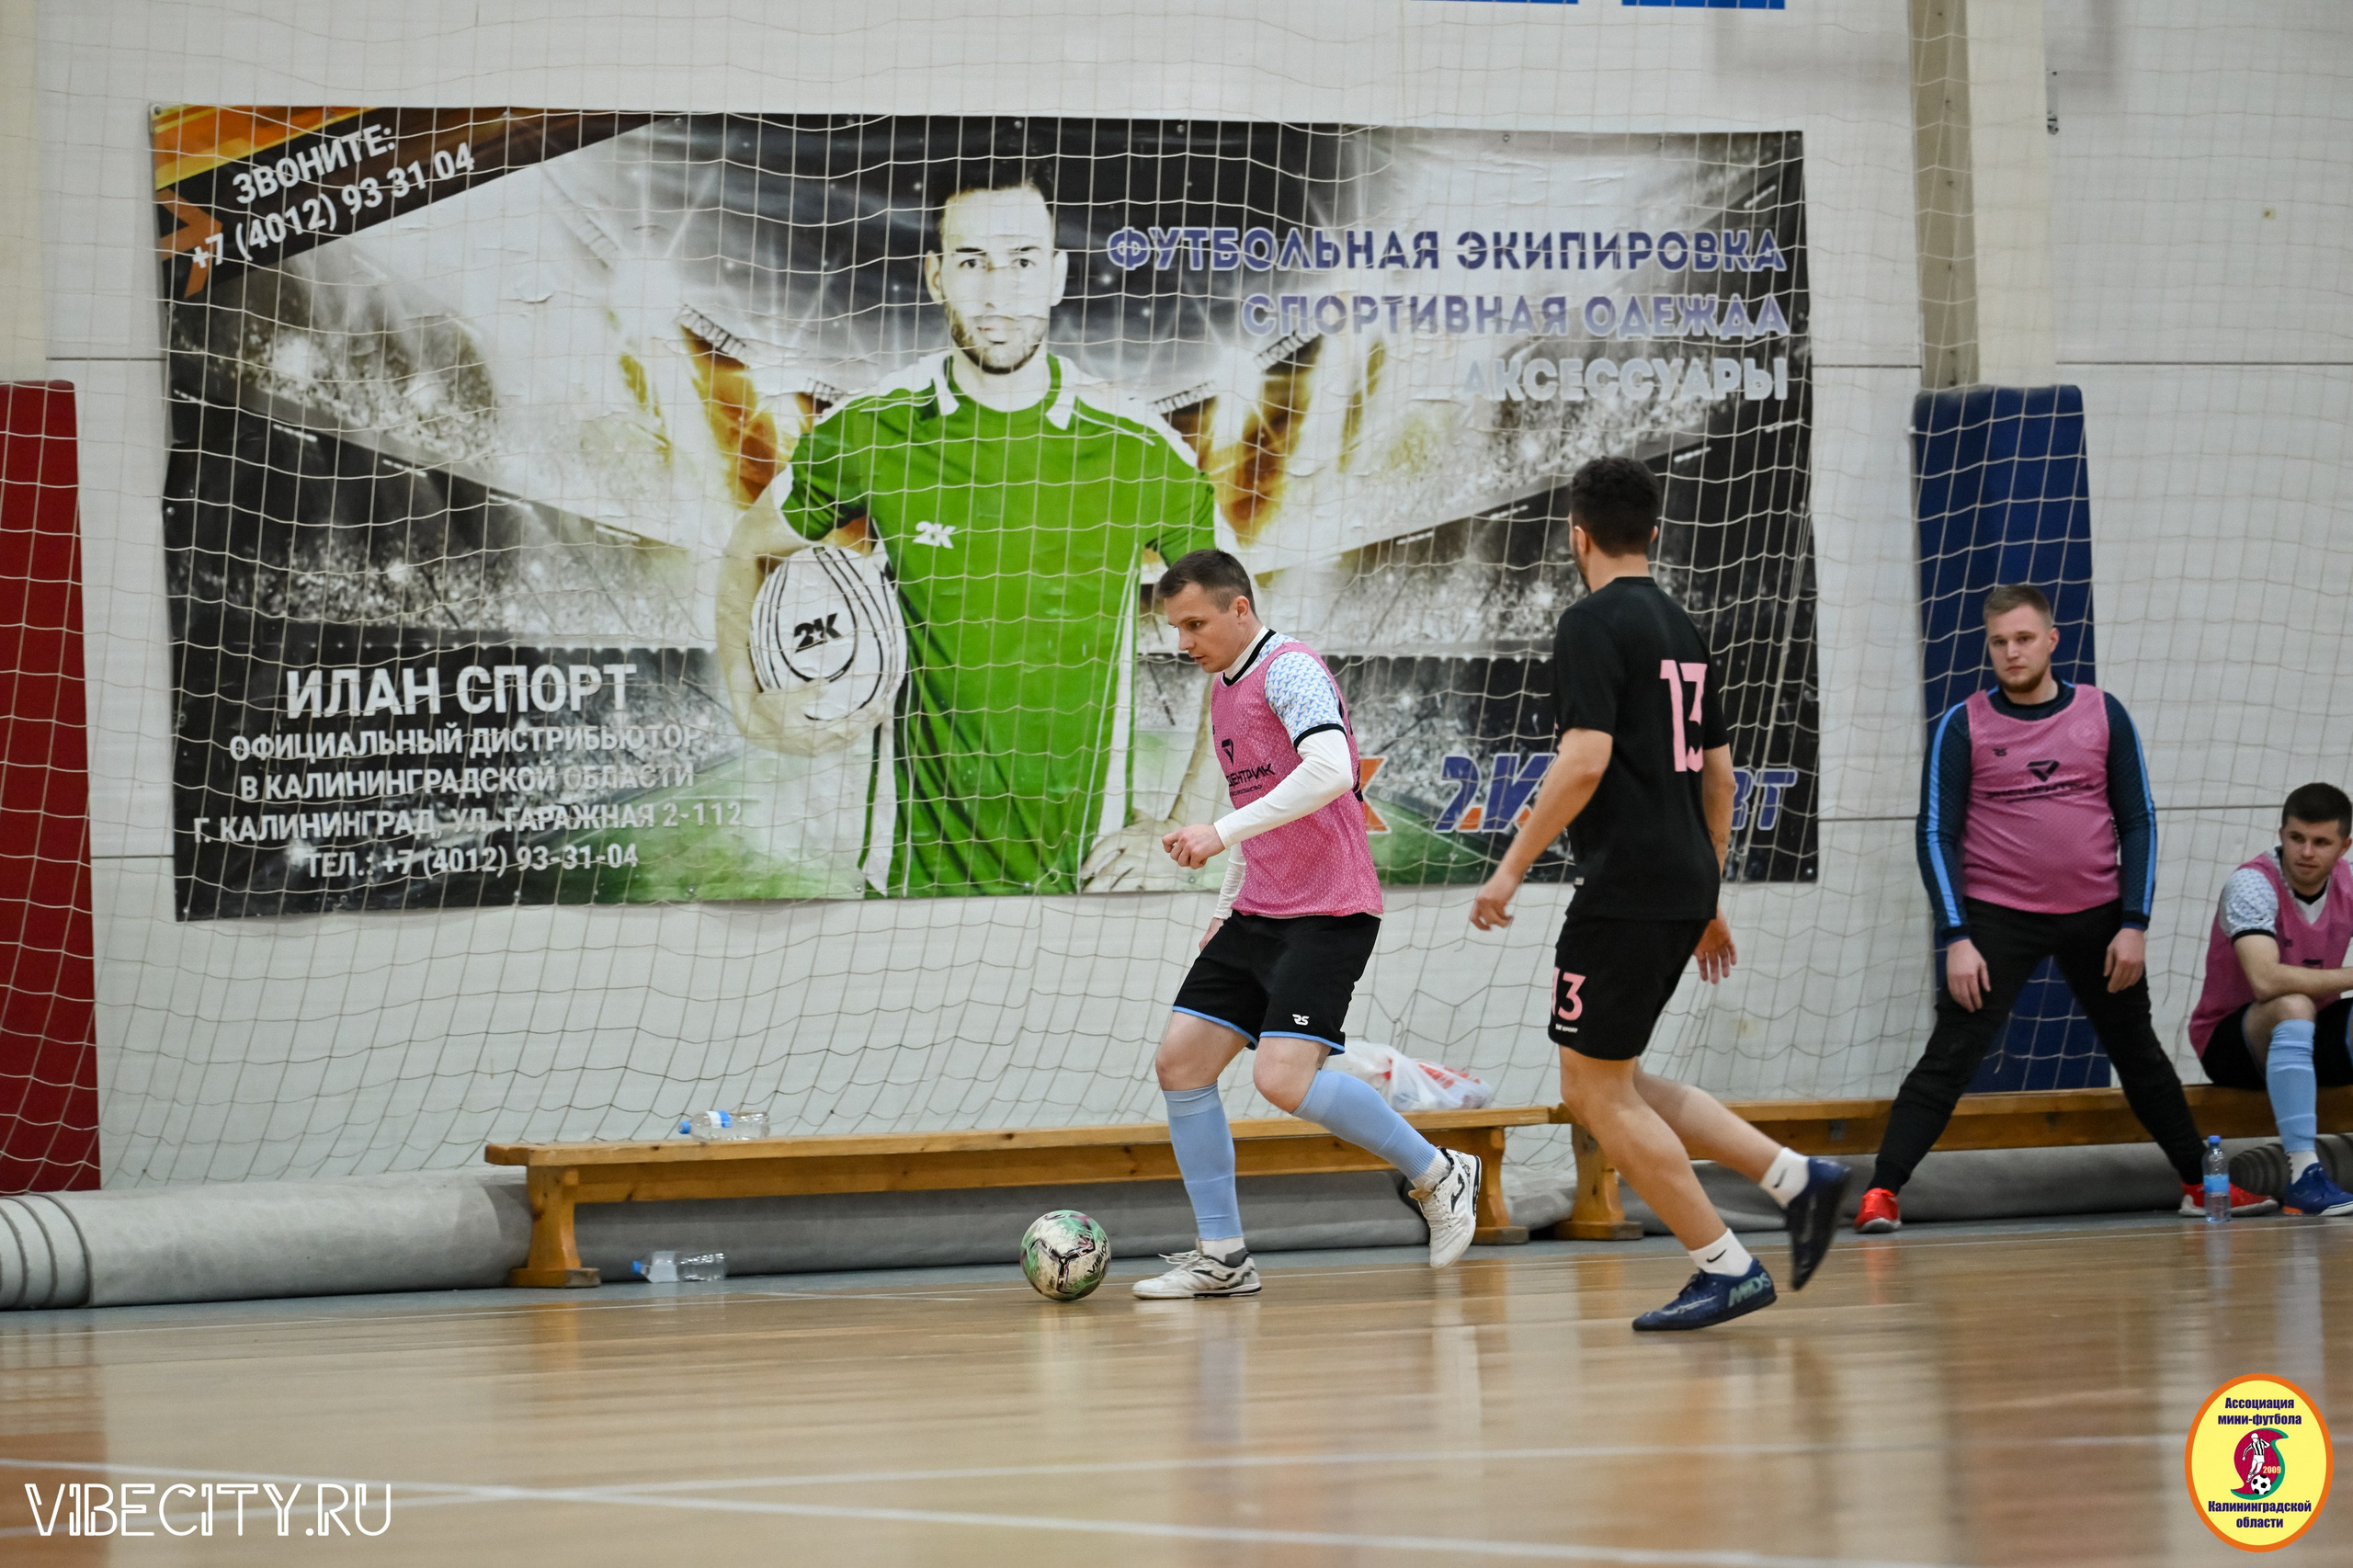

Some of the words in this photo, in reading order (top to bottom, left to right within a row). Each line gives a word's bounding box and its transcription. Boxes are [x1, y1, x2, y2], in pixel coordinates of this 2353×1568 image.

[233, 124, 396, 204] ЗВОНИТЕ:
[192, 232, 224, 268] +7
[235, 193, 336, 262] (4012)
[341, 177, 383, 216] 93
[386, 160, 427, 199] 31
[434, 142, 476, 180] 04
[1107, 227, 1439, 272] ФУТБОЛЬНАЯ
[1456, 230, 1788, 273] ЭКИПИРОВКА
[1242, 292, 1569, 338] СПОРТИВНАЯ
[1583, 292, 1790, 340] ОДЕЖДА
[1461, 357, 1789, 403] АКСЕССУАРЫ
[912, 520, 957, 550] 2K
[793, 612, 843, 653] 2K
[286, 666, 442, 720] ИЛАН
[457, 664, 637, 714] СПОРТ
[230, 722, 462, 764] ОФИЦИАЛЬНЫЙ
[470, 723, 703, 759] ДИСТРИБЬЮТОР
[241, 775, 258, 801] В
[265, 758, 556, 799] КАЛИНИНГРАДСКОЙ
[563, 762, 694, 792] ОБЛАСТИ
[194, 817, 211, 844] Г.
[220, 808, 442, 843] КАЛИНИНГРАД,
[505, 802, 655, 832] ГАРАЖНАЯ
[663, 801, 743, 826] 2-112
[382, 849, 413, 875] +7
[422, 844, 507, 880] (4012)
[517, 843, 639, 871] 93-31-04
